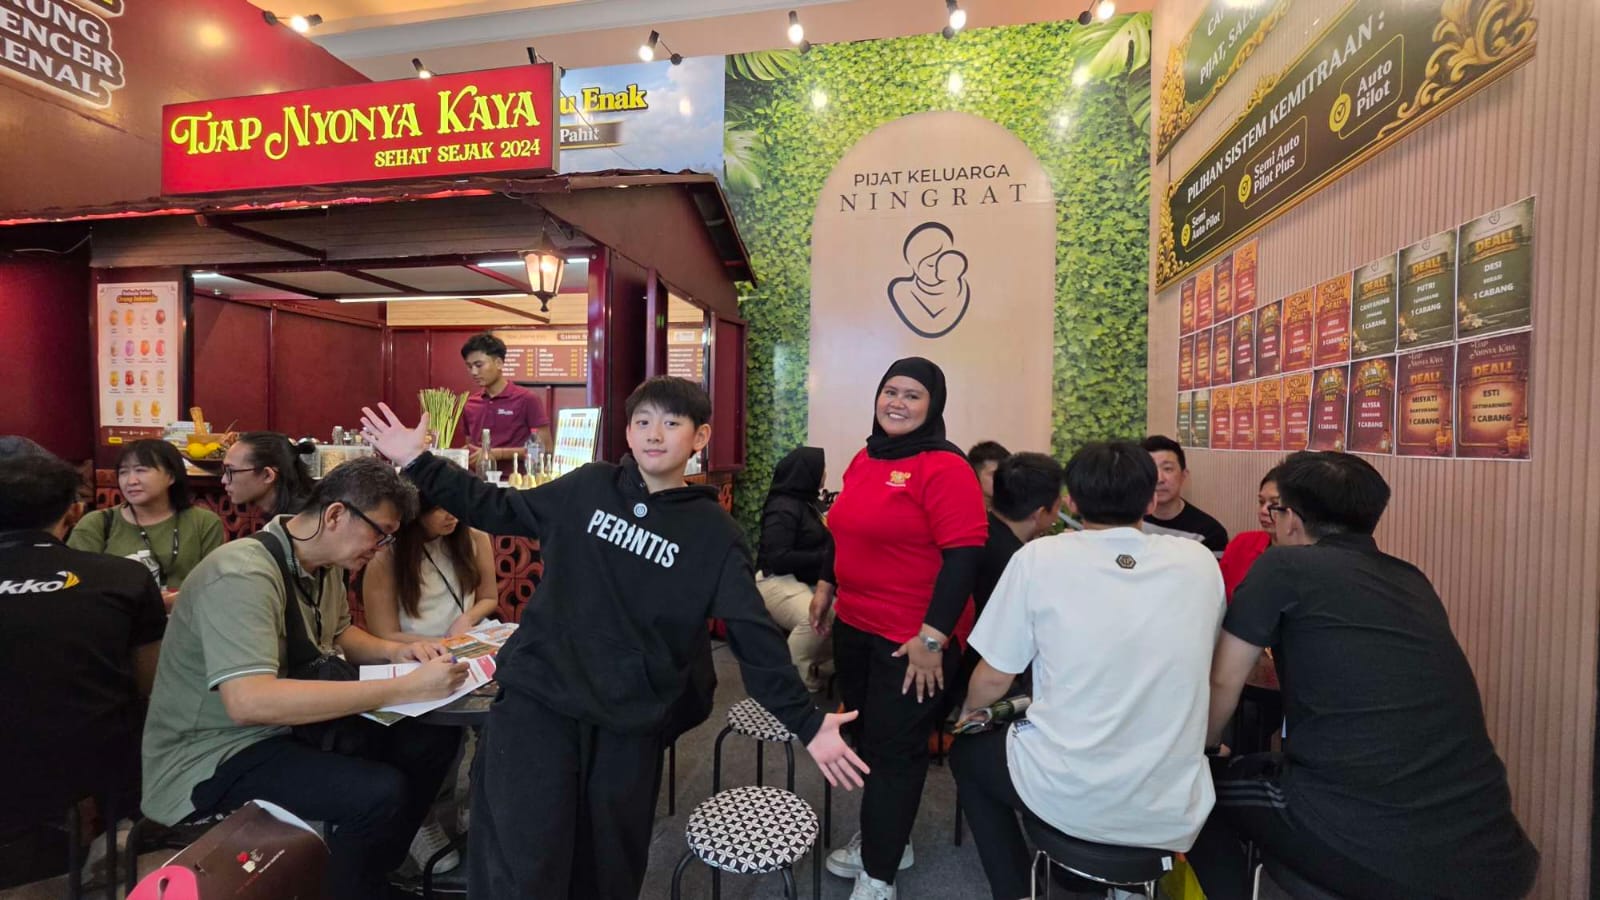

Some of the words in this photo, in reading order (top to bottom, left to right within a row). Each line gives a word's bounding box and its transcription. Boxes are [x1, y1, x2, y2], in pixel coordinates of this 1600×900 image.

[1357, 60, 1392, 97] Auto
[582, 83, 648, 112] Enak
[1356, 79, 1391, 117] Pilot
[1188, 158, 1224, 203] PILIHAN
[1225, 117, 1267, 169] SISTEM
[1269, 14, 1373, 129] KEMITRAAN
[171, 112, 262, 155] TJAP
[265, 103, 423, 160] NYONYA
[437, 85, 541, 134] KAYA
[560, 128, 600, 142] Pahit
[374, 147, 432, 168] SEHAT
[437, 142, 495, 164] SEJAK
[500, 138, 541, 159] 2024
[1254, 151, 1275, 178] Semi
[1277, 135, 1300, 162] Auto
[854, 171, 903, 187] PIJAT
[908, 164, 1010, 184] KELUARGA
[1253, 170, 1274, 194] Pilot
[1275, 155, 1295, 178] Plus
[840, 183, 1027, 212] NINGRAT
[1191, 207, 1207, 229] Semi
[1191, 222, 1206, 241] Auto
[1205, 211, 1221, 232] Pilot
[1475, 229, 1514, 253] DEAL!
[1412, 255, 1442, 275] DEAL!
[1484, 261, 1502, 273] DESI
[1363, 276, 1388, 292] DEAL!
[1416, 281, 1436, 293] PUTRI
[1478, 283, 1515, 299] CABANG
[1415, 302, 1441, 315] CABANG
[1366, 318, 1387, 329] CABANG
[1410, 371, 1440, 384] DEAL!
[1472, 361, 1513, 376] DEAL!
[1483, 389, 1500, 397] ESTI
[1413, 417, 1440, 425] CABANG
[1477, 414, 1513, 423] CABANG
